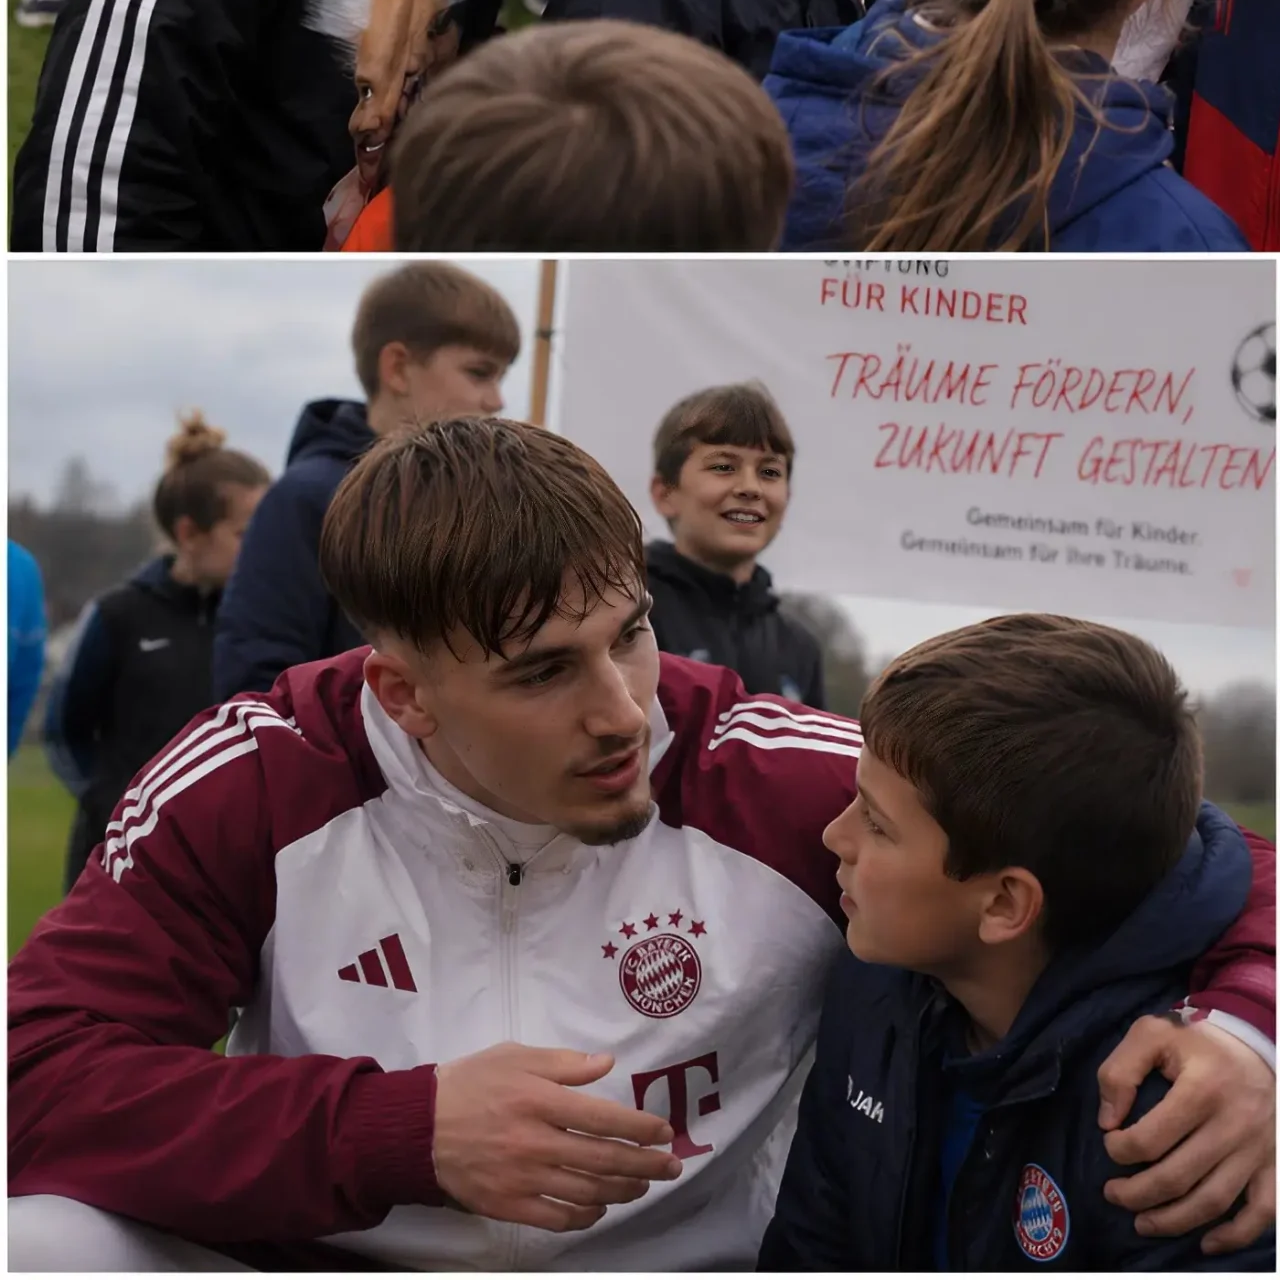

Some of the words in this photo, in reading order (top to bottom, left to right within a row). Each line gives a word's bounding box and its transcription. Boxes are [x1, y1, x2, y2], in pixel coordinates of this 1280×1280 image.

[822, 275, 884, 311] FÜR
[901, 286, 1026, 325] KINDER
[826, 345, 998, 405] TRÄUME
[1011, 359, 1195, 423] FÖRDERN,
[875, 423, 1063, 477] ZUKUNFT
[1078, 437, 1275, 490] GESTALTEN
[1030, 544, 1058, 562] für
[1096, 519, 1123, 538] für
